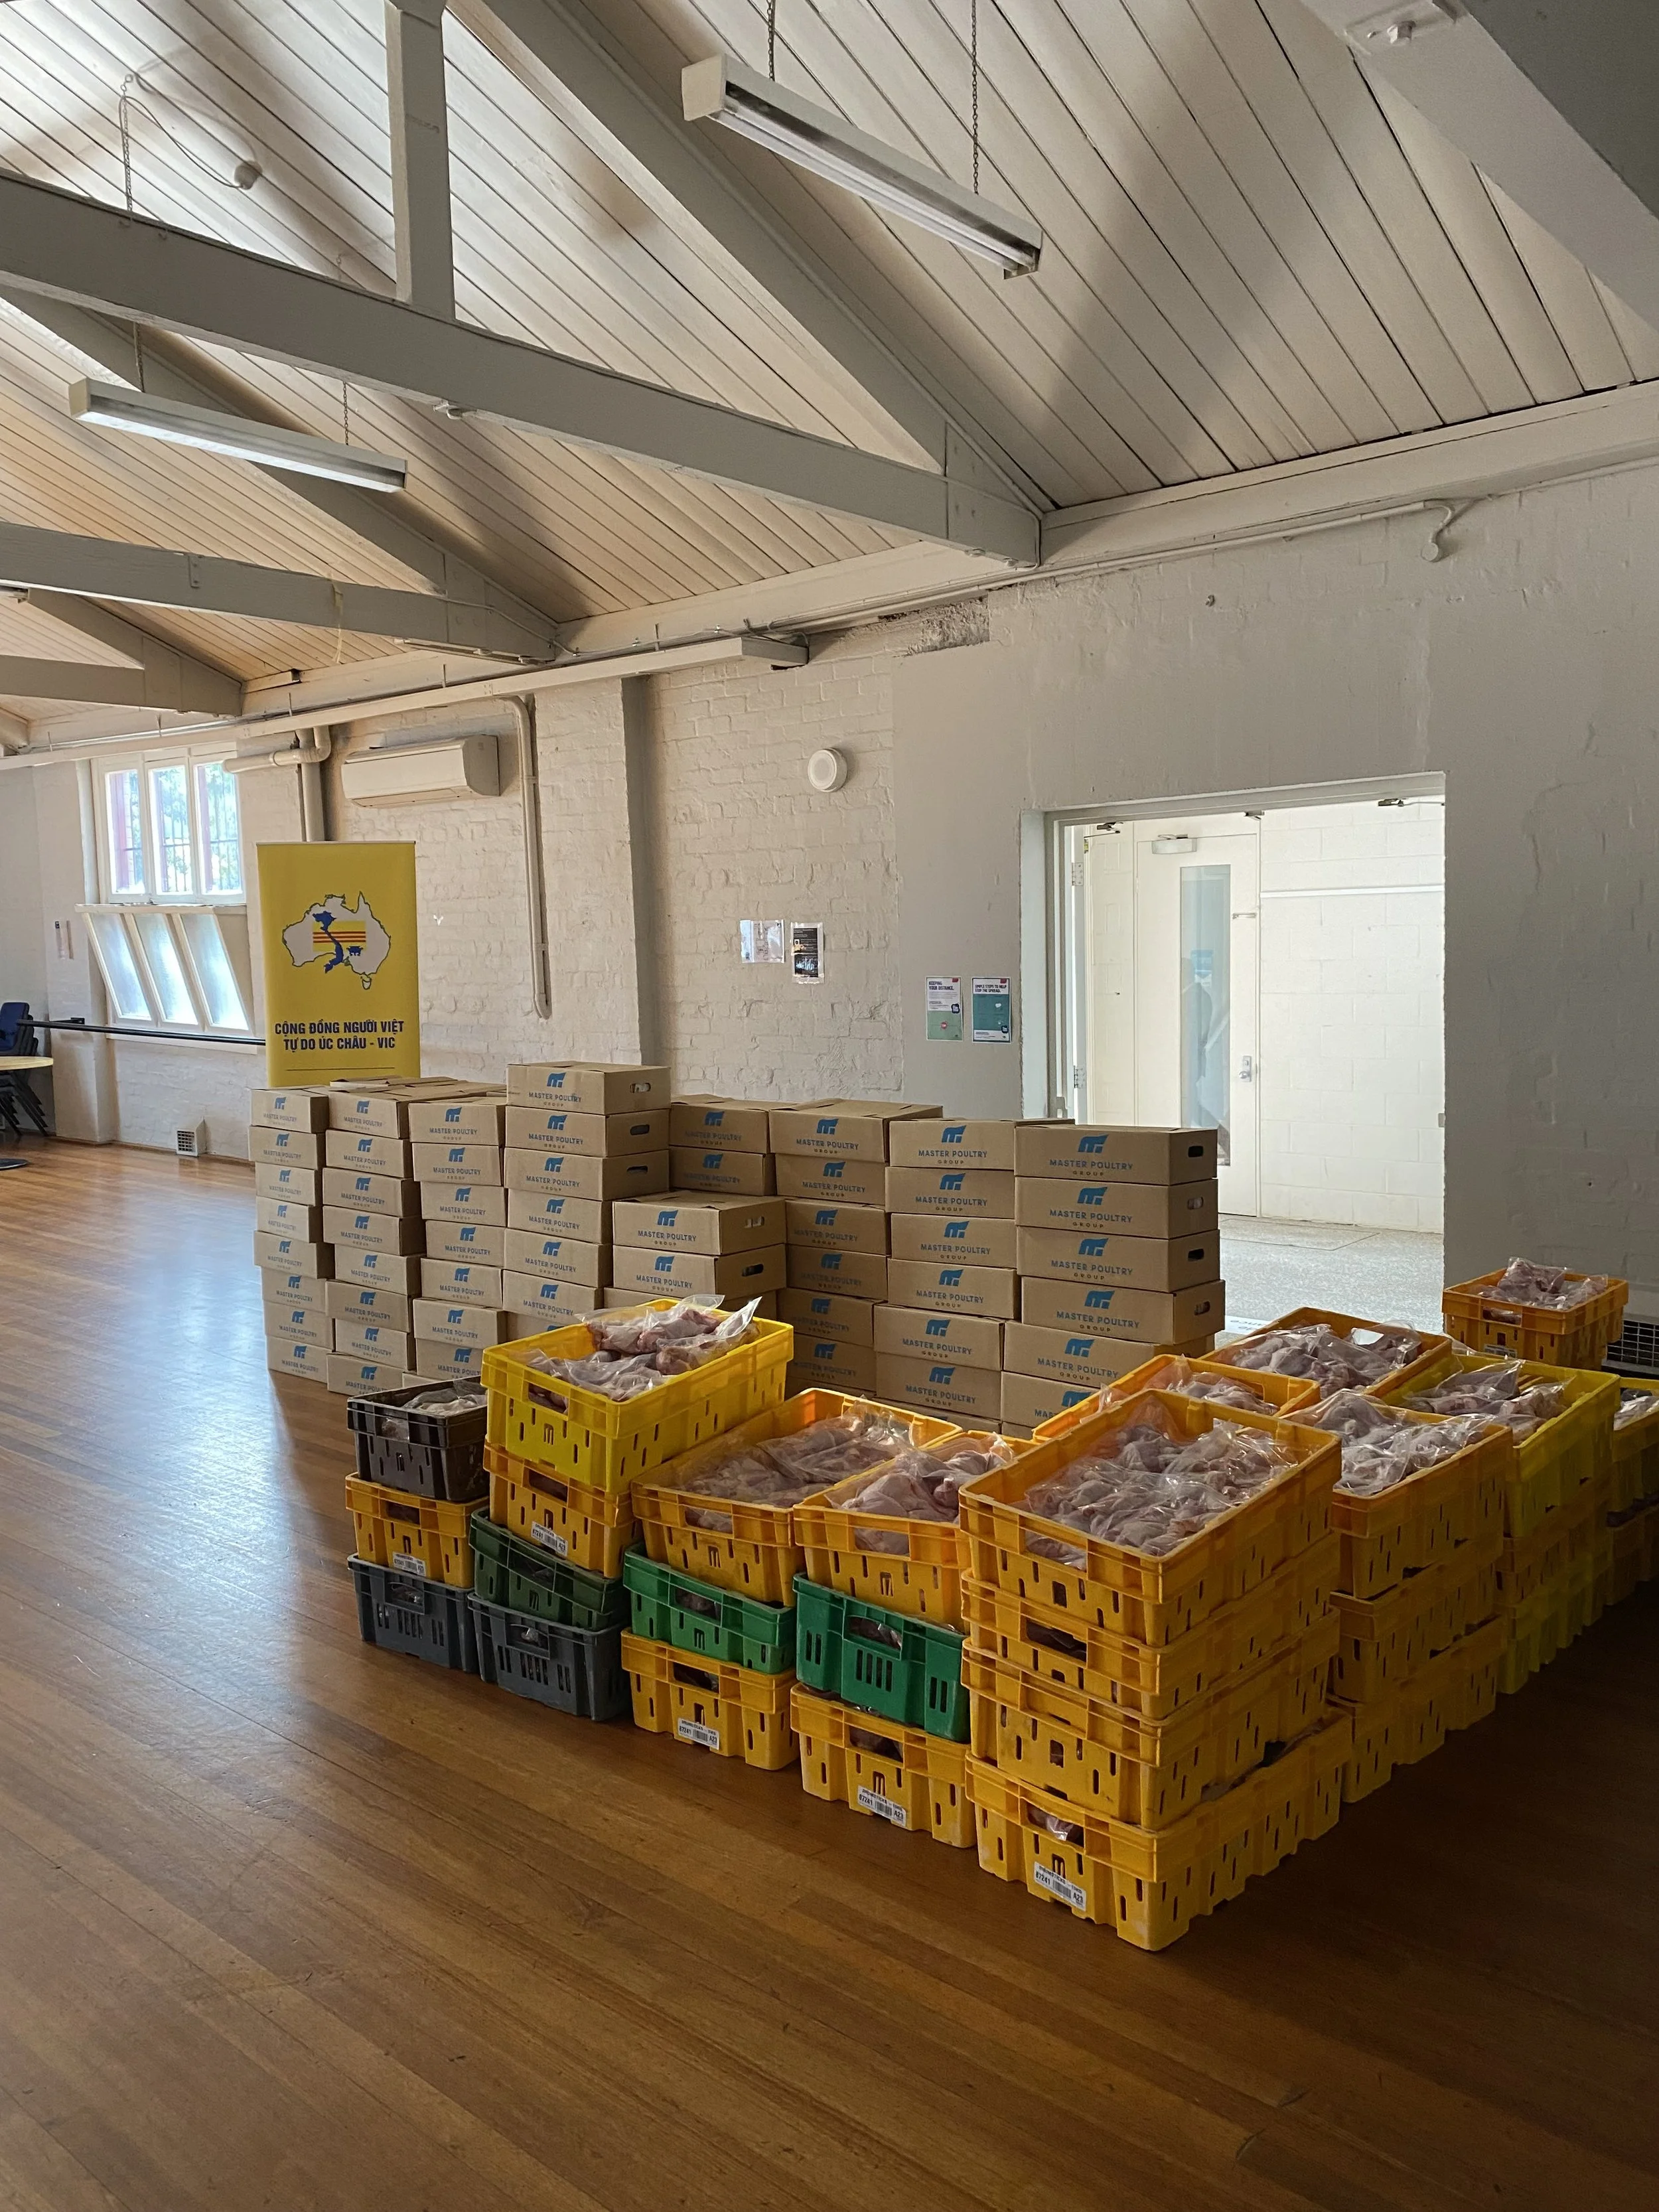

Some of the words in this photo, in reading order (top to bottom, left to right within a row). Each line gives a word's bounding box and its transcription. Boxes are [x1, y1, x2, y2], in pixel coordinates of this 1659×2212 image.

[275, 1021, 305, 1037] CỘNG
[309, 1019, 340, 1034] ĐỒNG
[344, 1019, 377, 1033] NGƯỜI
[380, 1019, 404, 1035] VIỆT
[283, 1037, 299, 1053] TỰ
[301, 1039, 316, 1051] DO
[319, 1036, 333, 1049] ÚC
[337, 1035, 366, 1049] CHÂU
[377, 1037, 396, 1049] VIC
[528, 1133, 553, 1142] MASTER
[556, 1136, 583, 1145] POULTRY
[827, 1142, 859, 1150] POULTRY
[1050, 1159, 1087, 1168] MASTER
[1091, 1161, 1133, 1170] POULTRY
[552, 1179, 580, 1187] POULTRY
[833, 1184, 865, 1193] POULTRY
[362, 1196, 385, 1205] POULTRY
[1050, 1210, 1086, 1219] MASTER
[1090, 1213, 1132, 1222] POULTRY
[529, 1216, 551, 1225] MASTER
[553, 1220, 580, 1230] POULTRY
[340, 1231, 360, 1240] MASTER
[667, 1233, 697, 1242] POULTRY
[826, 1232, 858, 1241] POULTRY
[921, 1244, 952, 1252] MASTER
[956, 1246, 990, 1254] POULTRY
[526, 1258, 548, 1267] MASTER
[550, 1262, 577, 1272] POULTRY
[1051, 1260, 1088, 1270] MASTER
[1091, 1264, 1133, 1276] POULTRY
[351, 1269, 368, 1278] MASTER
[636, 1275, 662, 1284] MASTER
[664, 1278, 693, 1288] POULTRY
[916, 1290, 946, 1299] MASTER
[950, 1293, 983, 1303] POULTRY
[345, 1306, 366, 1315] MASTER
[524, 1300, 546, 1310] MASTER
[548, 1305, 573, 1315] POULTRY
[1056, 1311, 1094, 1323] MASTER
[1098, 1316, 1139, 1328] POULTRY
[279, 1325, 297, 1333] MASTER
[432, 1327, 453, 1335] MASTER
[454, 1330, 478, 1339] POULTRY
[902, 1338, 934, 1349] MASTER
[937, 1343, 972, 1355] POULTRY
[438, 1364, 461, 1373] MASTER
[1038, 1358, 1073, 1371] MASTER
[1078, 1364, 1119, 1378] POULTRY
[906, 1384, 937, 1397] MASTER
[940, 1391, 976, 1404] POULTRY
[1035, 1409, 1056, 1419] MAS
[680, 1726, 691, 1734] 87241
[859, 1794, 873, 1805] 87241
[894, 1810, 903, 1819] A23
[1036, 1872, 1050, 1885] 87241
[1074, 1893, 1083, 1903] A23
